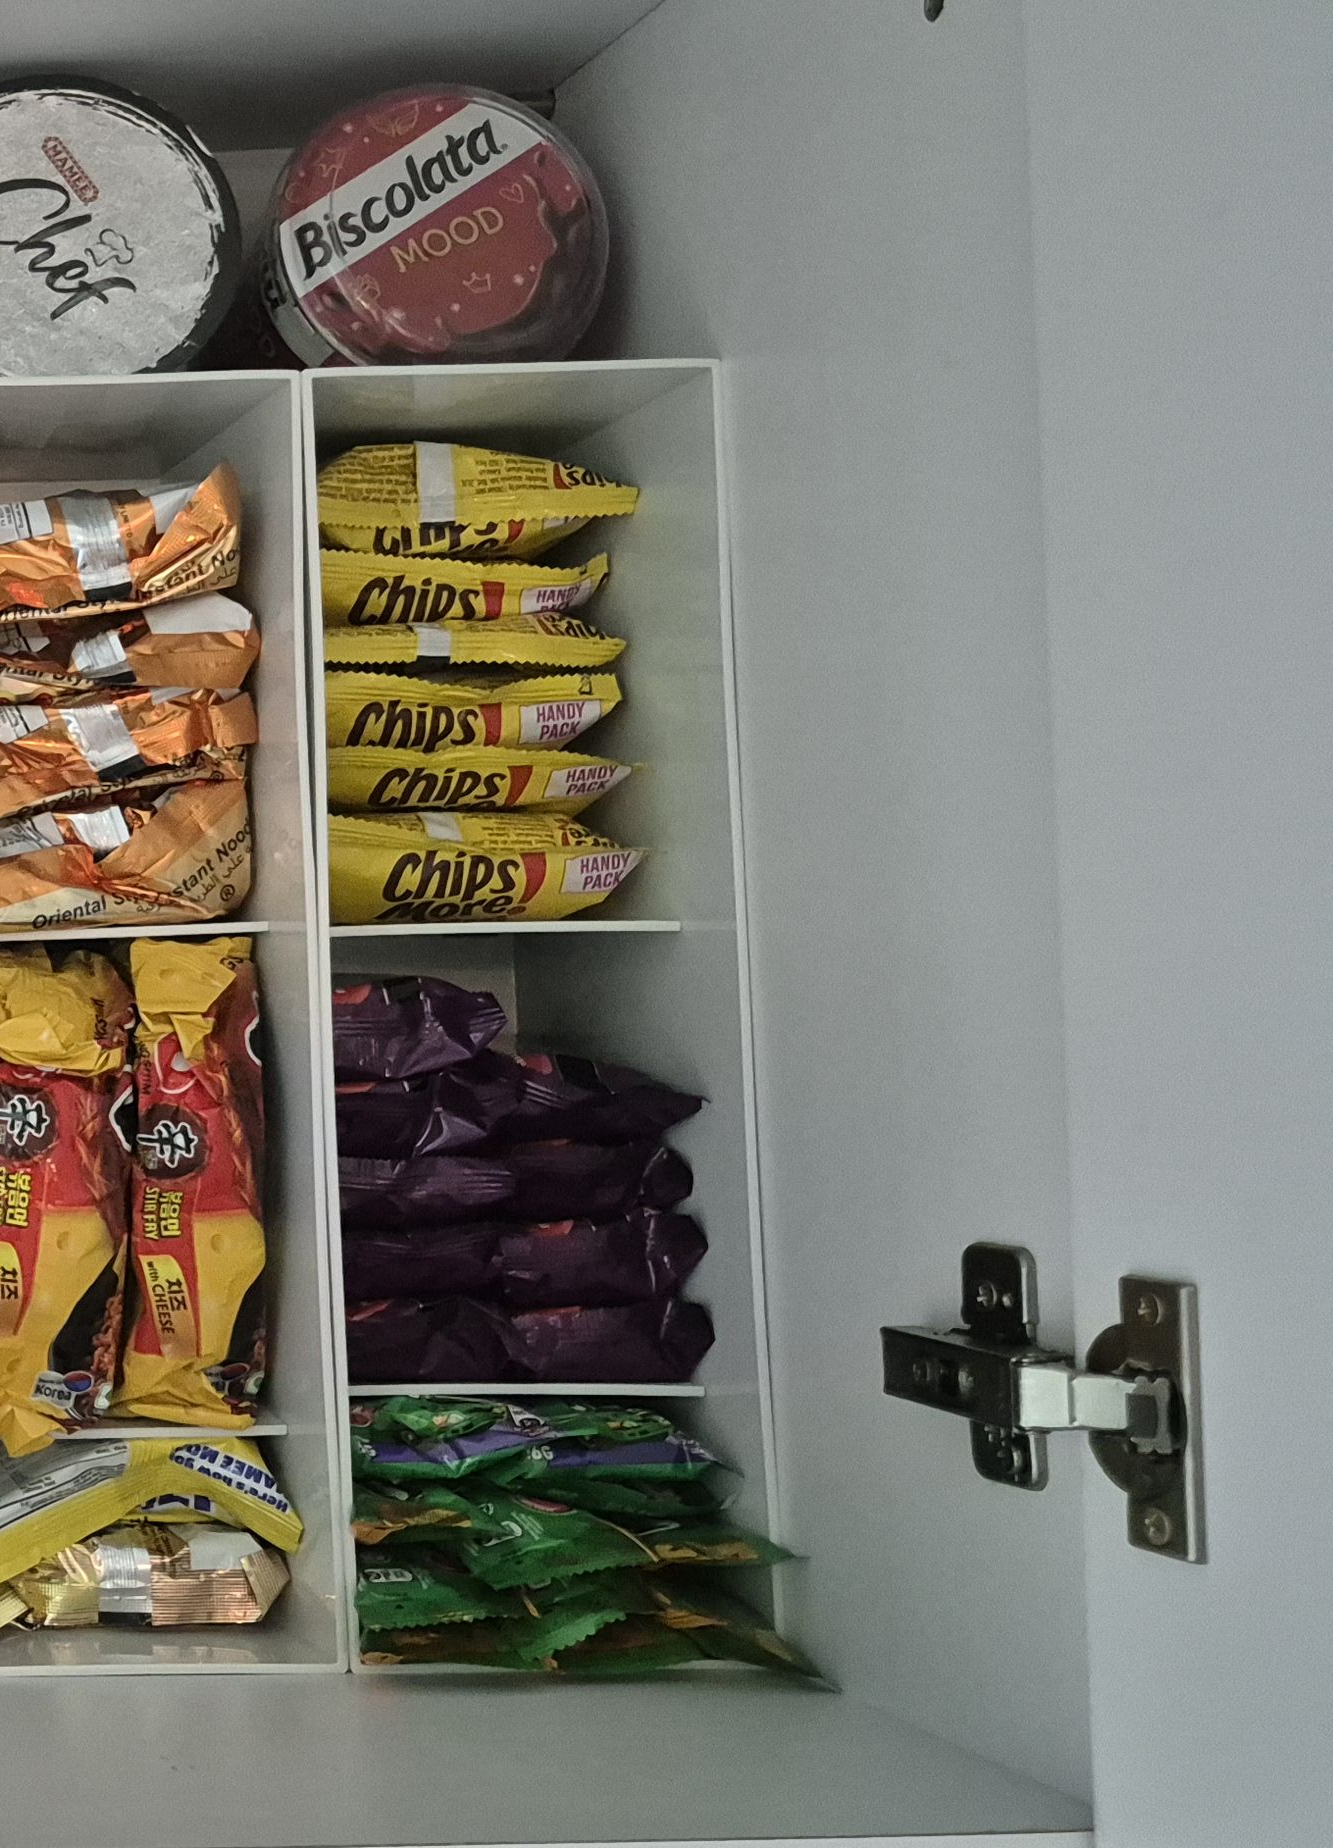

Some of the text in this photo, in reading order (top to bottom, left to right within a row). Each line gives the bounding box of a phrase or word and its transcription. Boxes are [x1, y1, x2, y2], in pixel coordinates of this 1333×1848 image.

[46, 141, 95, 197] MAMEE
[294, 119, 502, 280] Biscolata
[390, 206, 504, 273] MOOD
[347, 574, 480, 626] Chips
[536, 584, 582, 603] HANDY
[346, 700, 478, 752] Chips
[536, 702, 584, 723] HANDY
[539, 720, 581, 741] PACK
[368, 764, 508, 807] Chips
[565, 765, 618, 782] HANDY
[566, 779, 609, 796] PACK
[172, 859, 216, 898] stant
[383, 850, 521, 903] Chips
[580, 853, 632, 875] HANDY
[583, 870, 625, 892] PACK
[32, 894, 107, 929] Oriental
[374, 894, 515, 921] More
[142, 1186, 159, 1241] STIR FRY
[0, 1266, 19, 1301] 치즈
[146, 1260, 176, 1334] with CHEESE
[164, 1277, 187, 1312] 치즈
[35, 1383, 72, 1401] Korea
[169, 1453, 196, 1473] yo
[222, 1454, 277, 1490] AMEE
[235, 1482, 289, 1513] Here's
